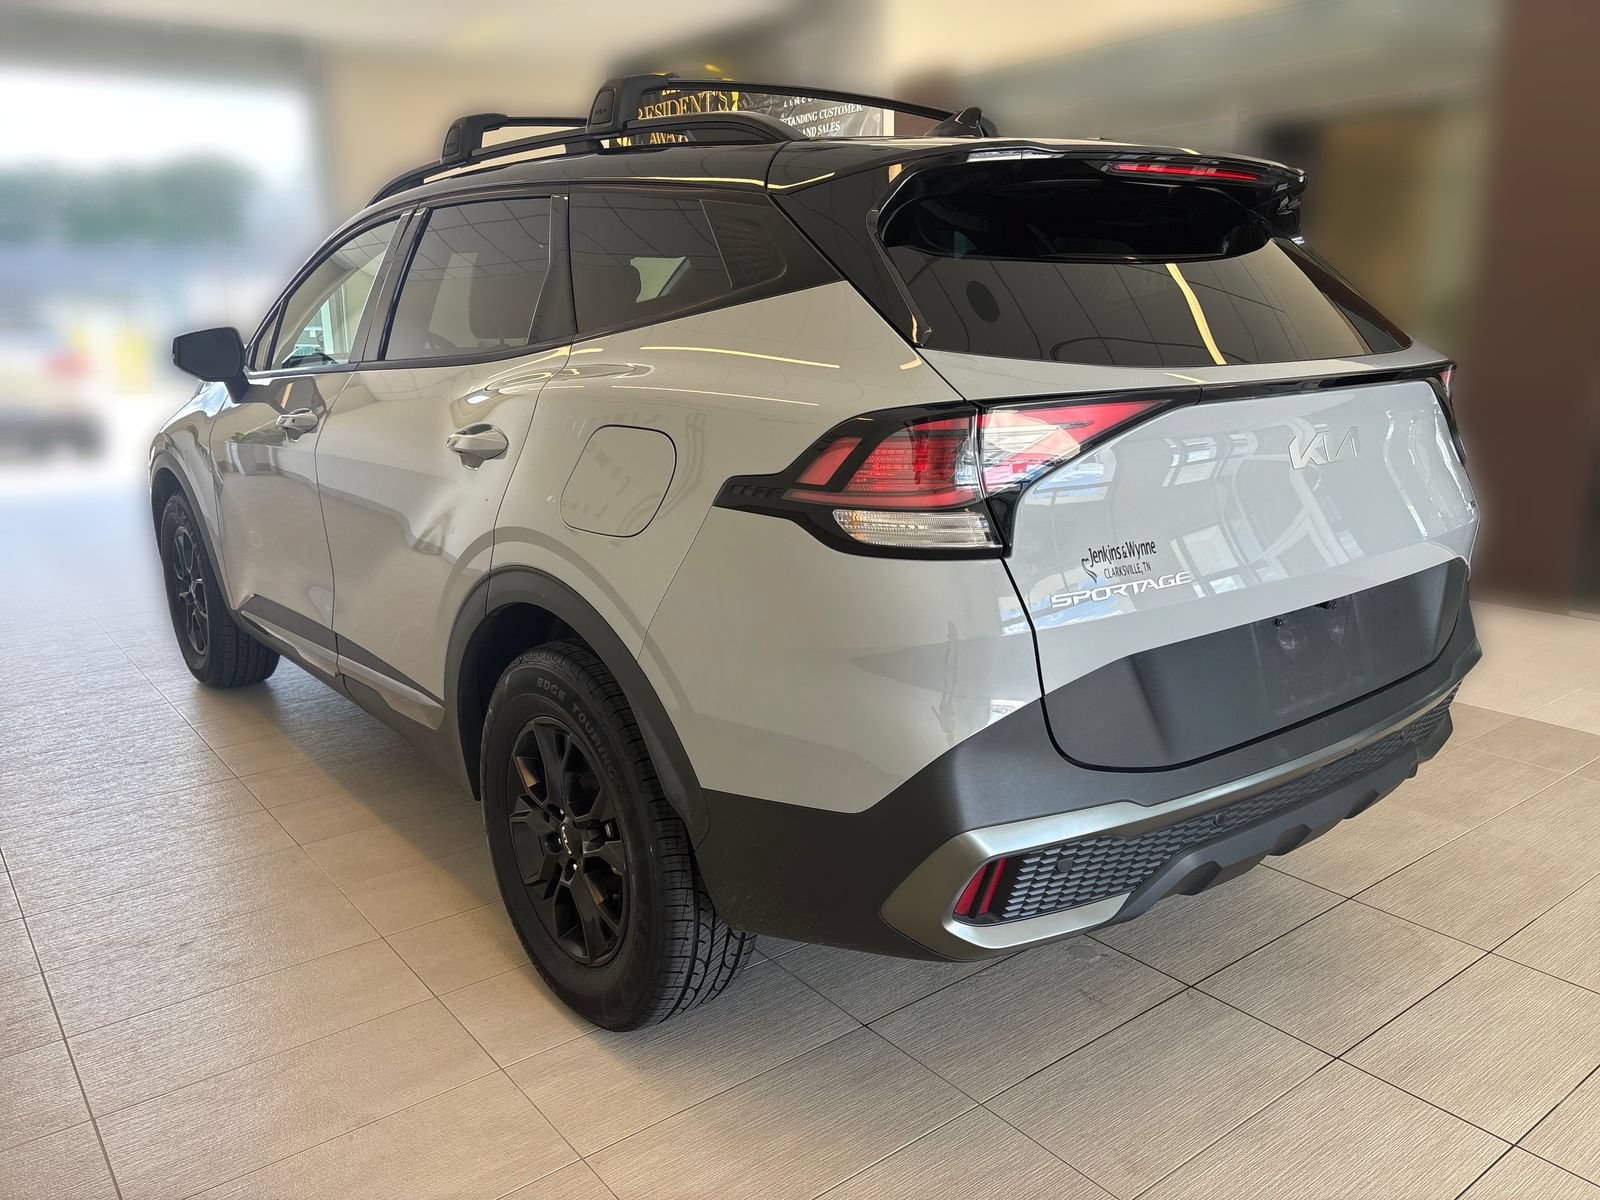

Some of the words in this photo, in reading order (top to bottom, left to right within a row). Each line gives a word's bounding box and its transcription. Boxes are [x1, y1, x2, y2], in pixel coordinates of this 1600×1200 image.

[783, 96, 817, 108] LINC
[819, 103, 864, 120] CUSTOMER
[817, 121, 841, 137] SALES
[1103, 563, 1144, 580] CLARKSVILLE,
[1142, 561, 1152, 572] TN
[1050, 571, 1192, 608] SPORTAGE
[536, 677, 566, 701] EDGE
